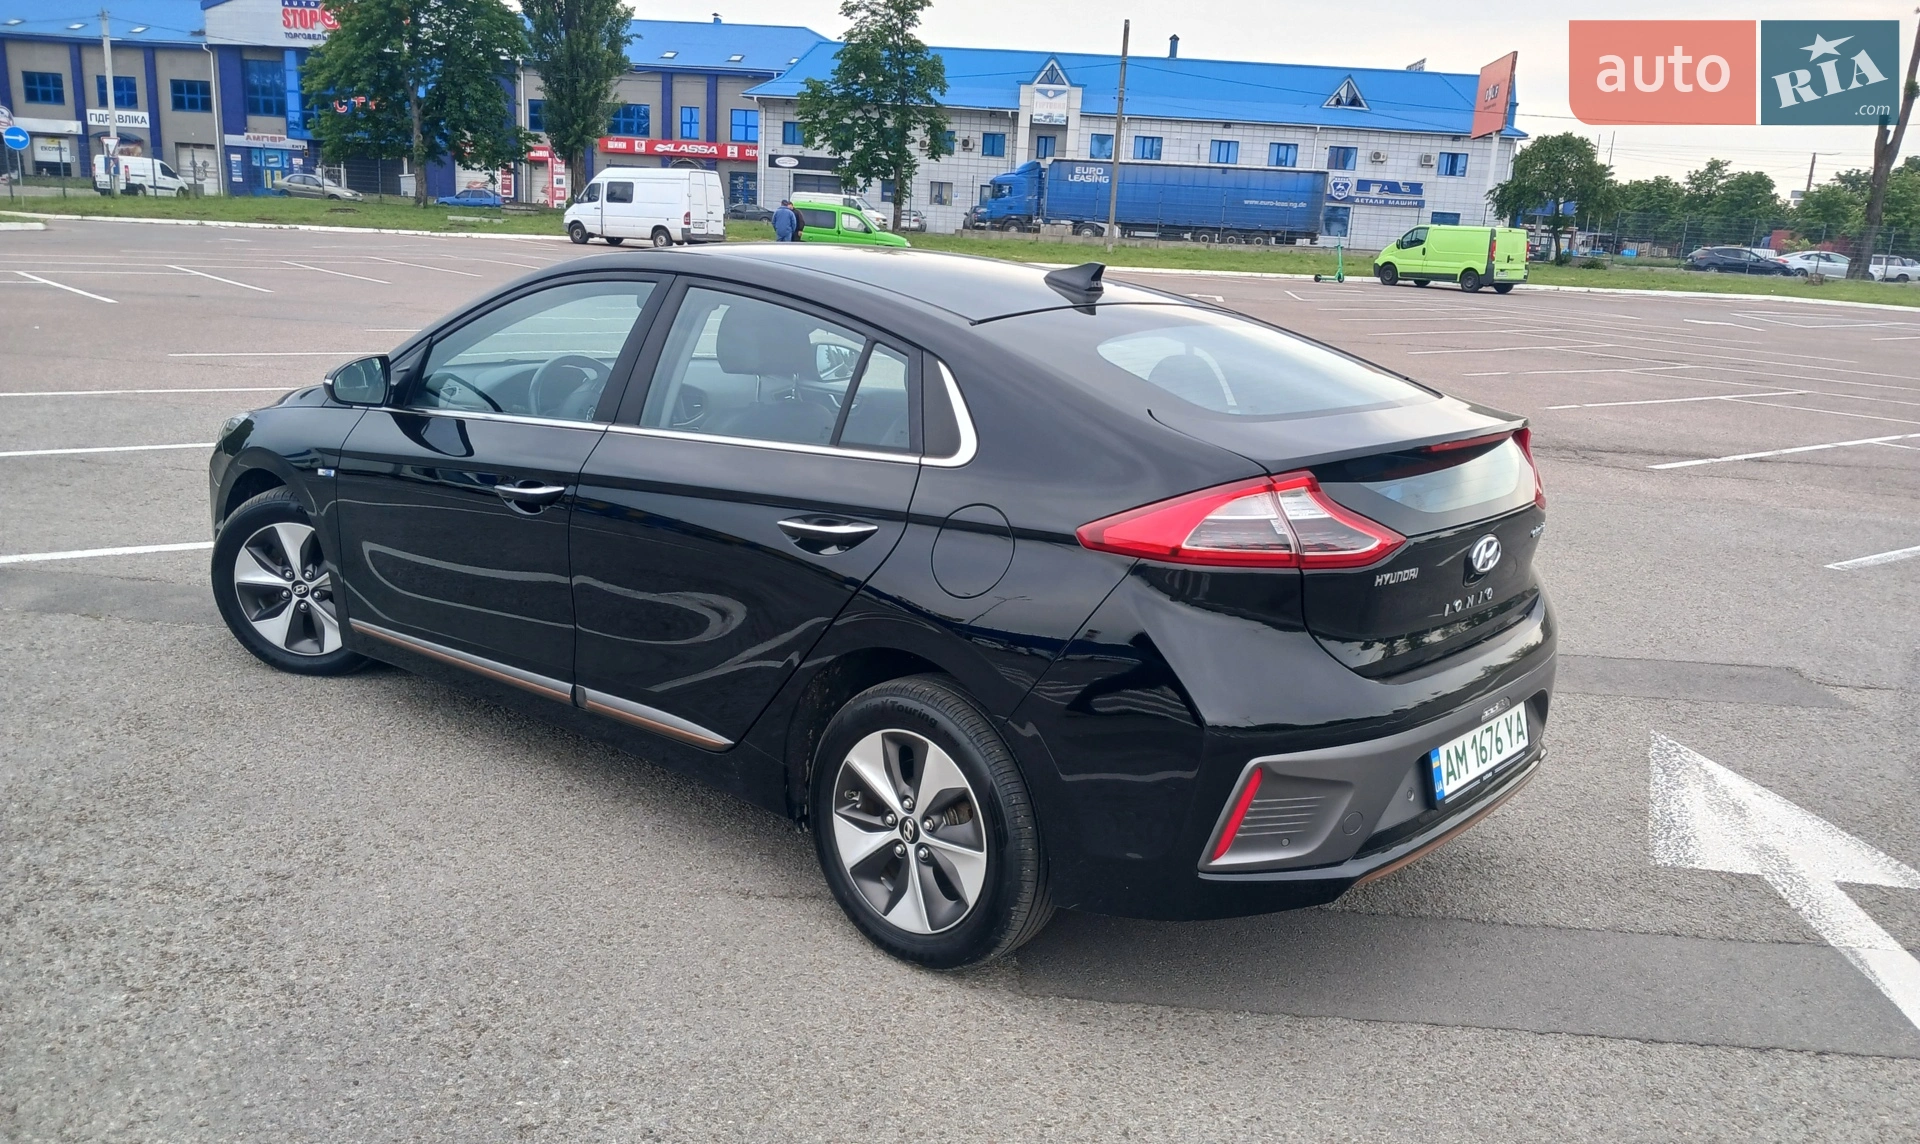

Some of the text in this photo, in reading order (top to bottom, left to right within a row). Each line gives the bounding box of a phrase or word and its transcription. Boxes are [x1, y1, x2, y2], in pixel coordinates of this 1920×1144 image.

[282, 8, 320, 30] STOP
[245, 134, 286, 142] АМПЕР
[607, 140, 627, 150] ШИНИ
[671, 142, 718, 155] LASSA
[1075, 166, 1104, 175] EURO
[1068, 174, 1110, 183] LEASING
[1356, 179, 1424, 196] ГАЗ
[1374, 567, 1419, 587] HYUNDAI
[1444, 587, 1494, 617] IONIQ
[1445, 711, 1526, 786] AM 1676 YA
[1436, 781, 1444, 793] UA
